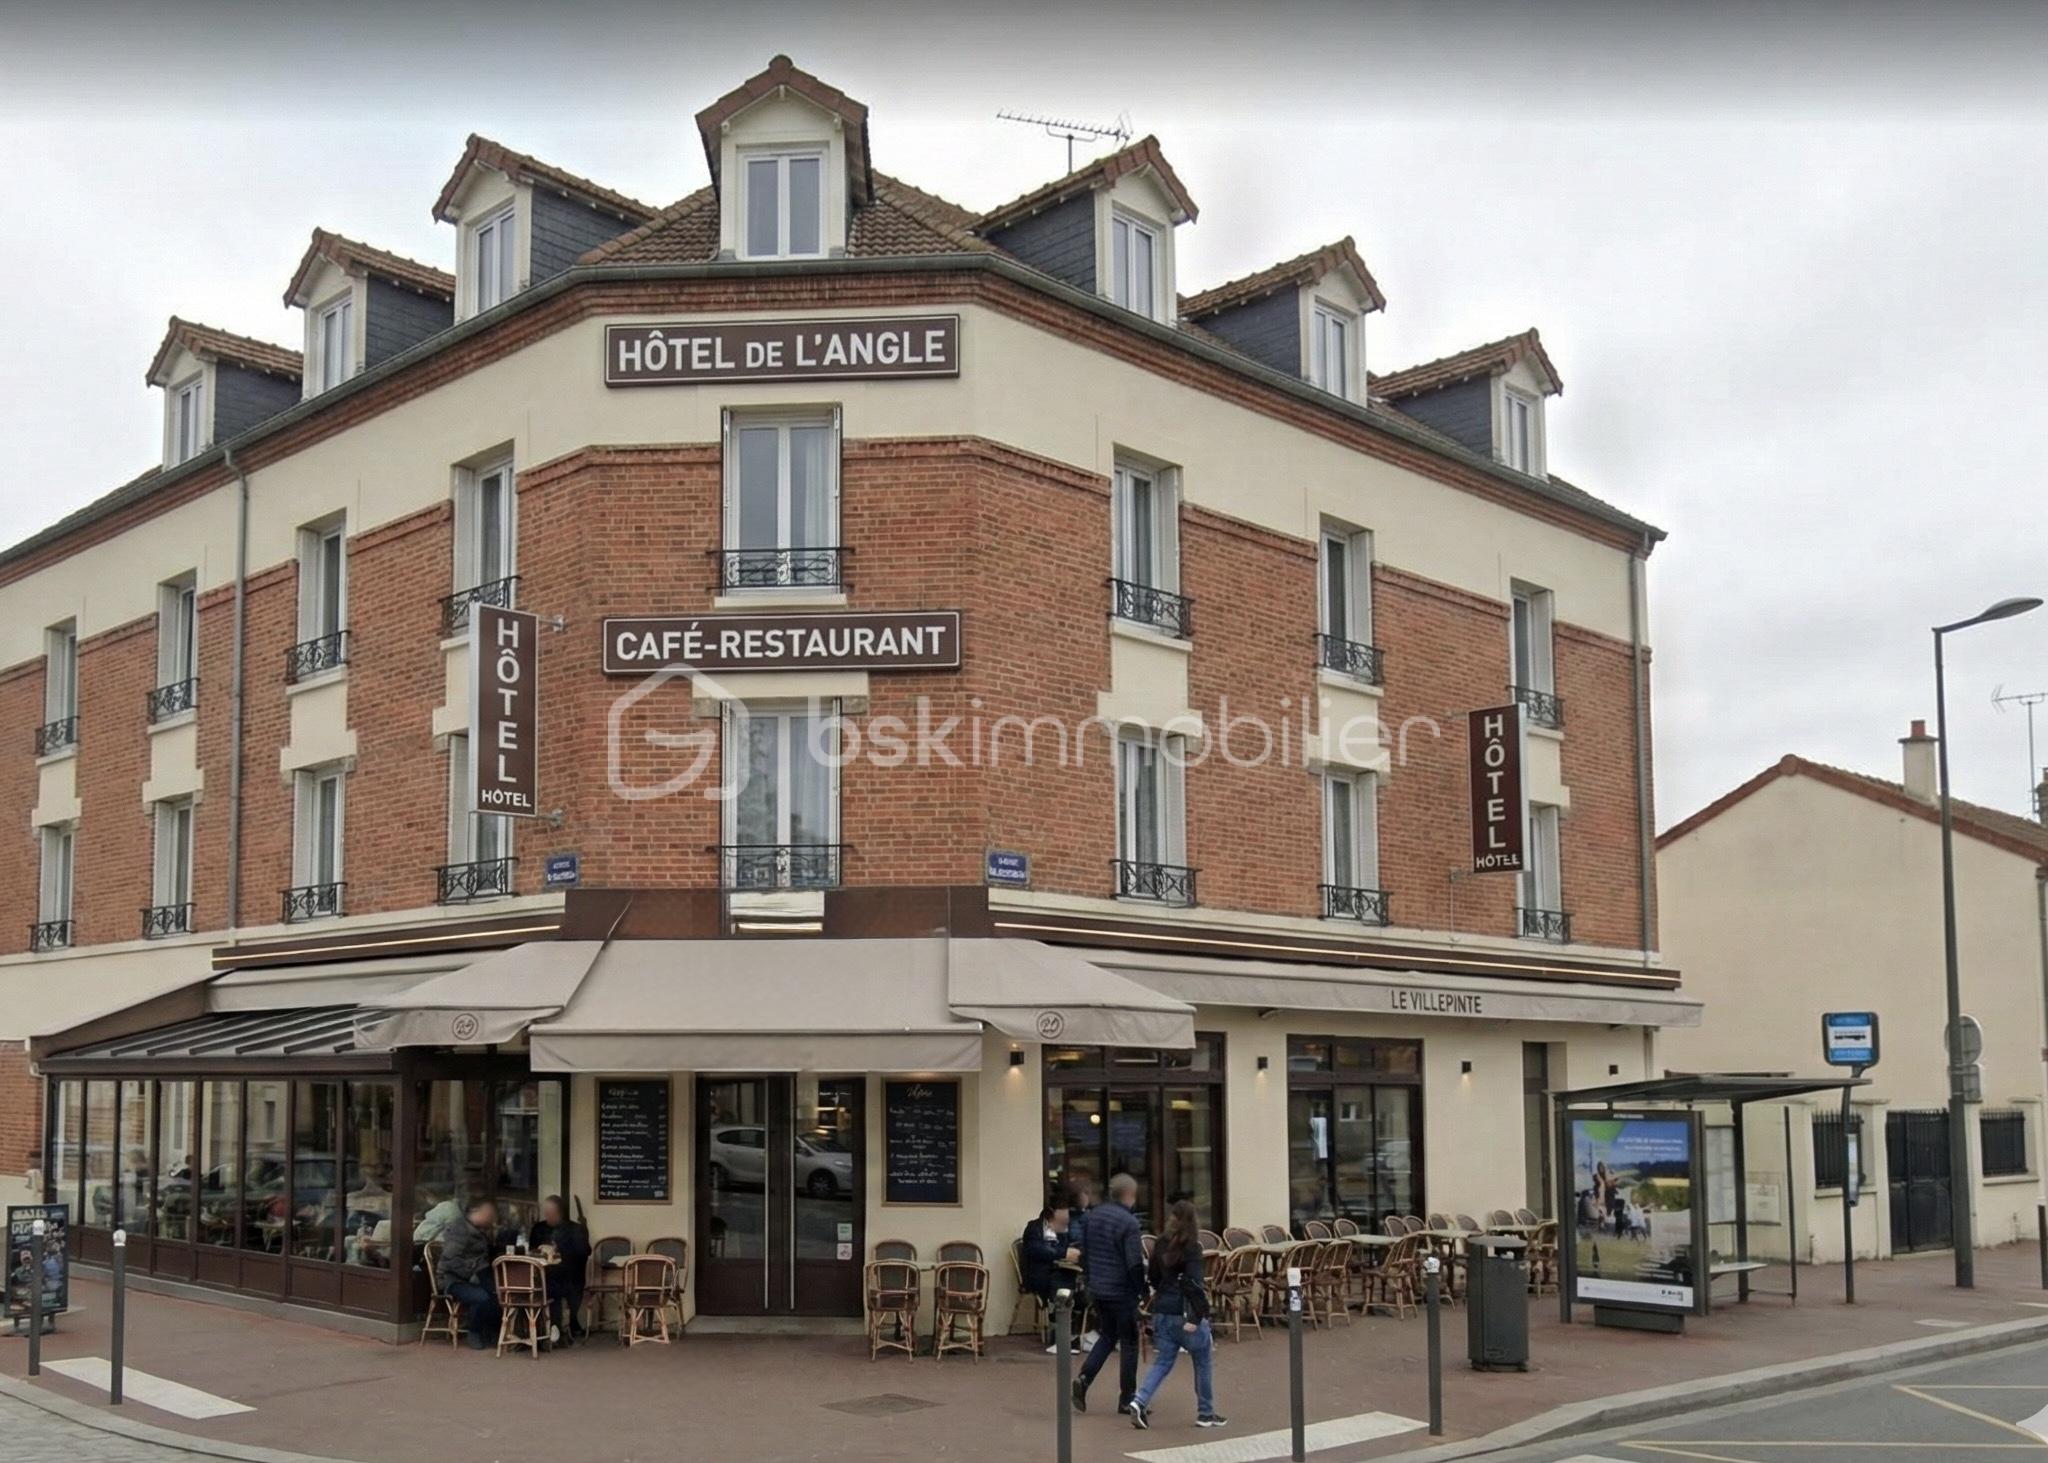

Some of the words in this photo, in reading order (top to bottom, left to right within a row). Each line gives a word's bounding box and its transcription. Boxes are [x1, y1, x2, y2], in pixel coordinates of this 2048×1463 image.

[617, 330, 735, 372] HÔTEL
[745, 341, 784, 368] DE
[796, 330, 946, 367] L'ANGLE
[616, 621, 946, 661] CAFÉ-RESTAURANT
[496, 617, 521, 783] HÔTEL
[481, 789, 532, 808] HÔTEL
[1484, 713, 1506, 849] HÔTEL
[1476, 853, 1521, 869] HÔTEL
[1391, 989, 1407, 1010] LE
[1410, 991, 1482, 1014] VILLEPINTE
